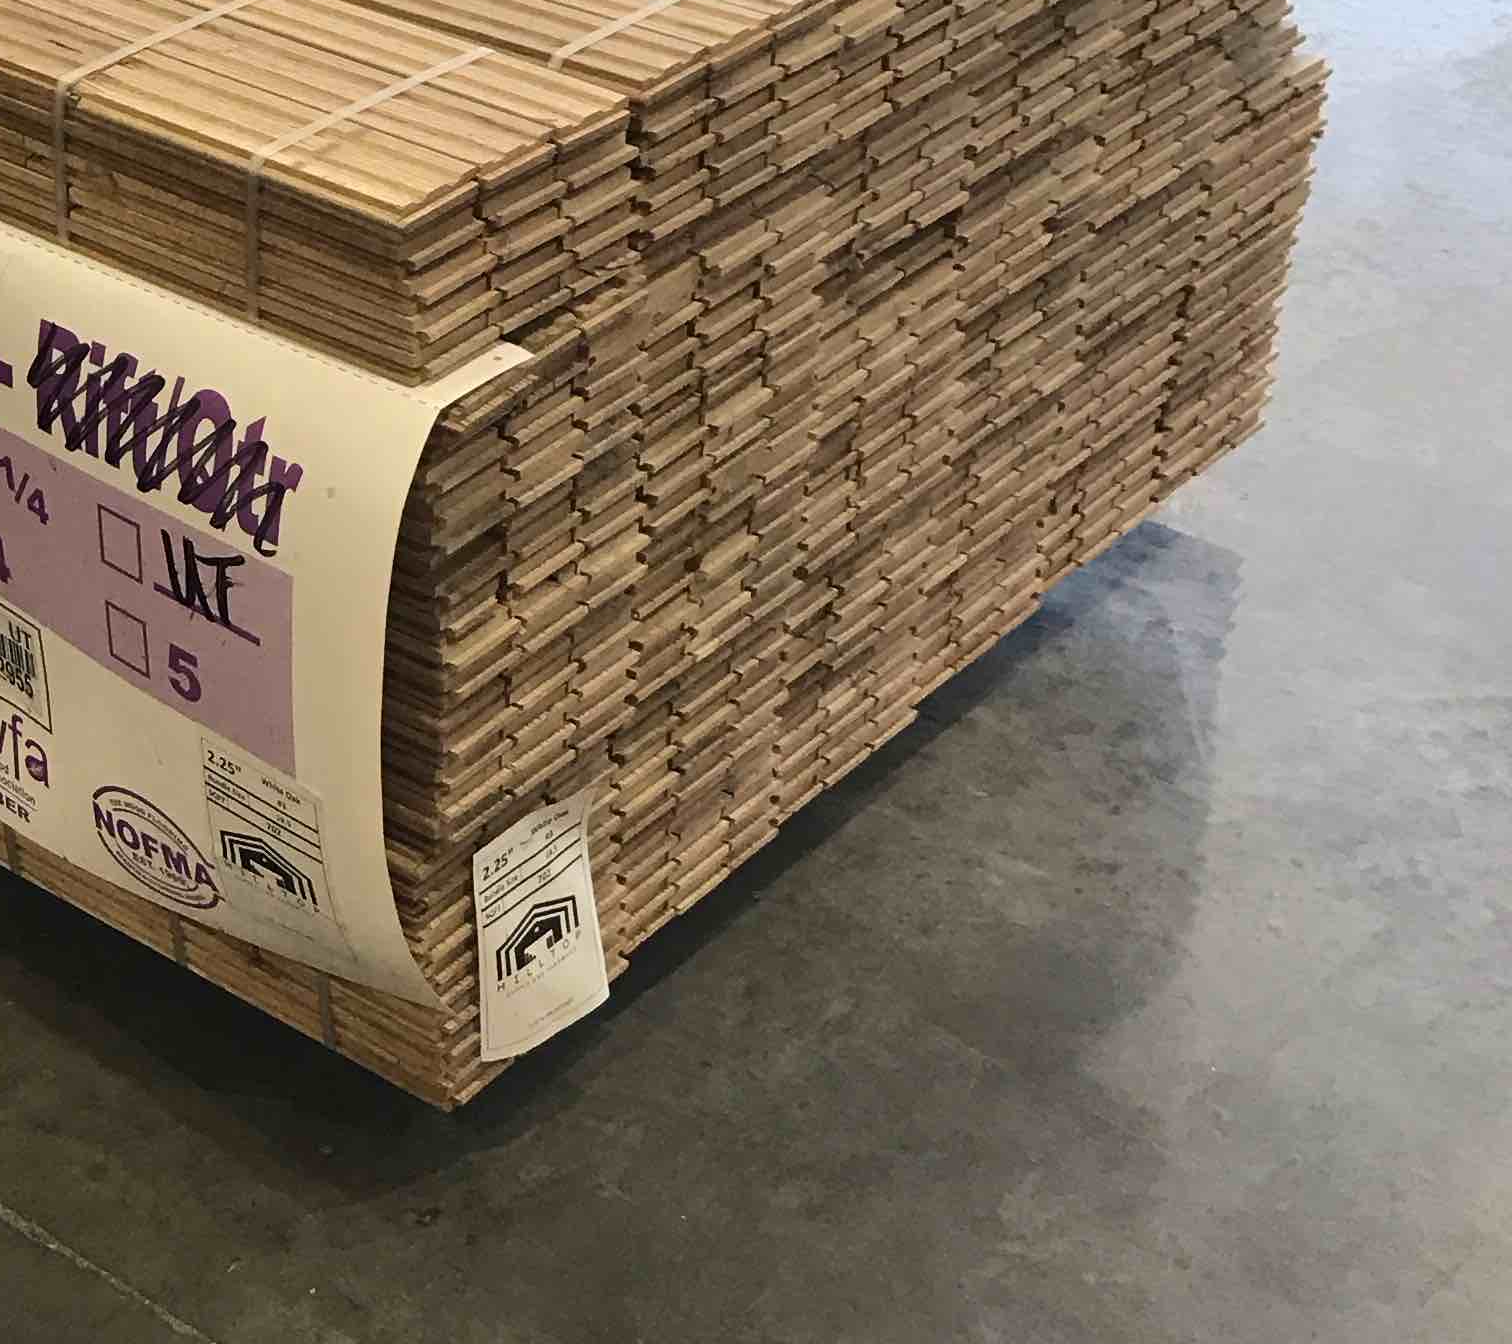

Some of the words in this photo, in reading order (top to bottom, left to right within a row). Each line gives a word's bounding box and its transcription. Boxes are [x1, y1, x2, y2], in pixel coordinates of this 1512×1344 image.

[167, 643, 202, 703] 5
[207, 749, 242, 775] 2.25"
[92, 799, 220, 893] NOFMA
[481, 846, 515, 882] 2.25"
